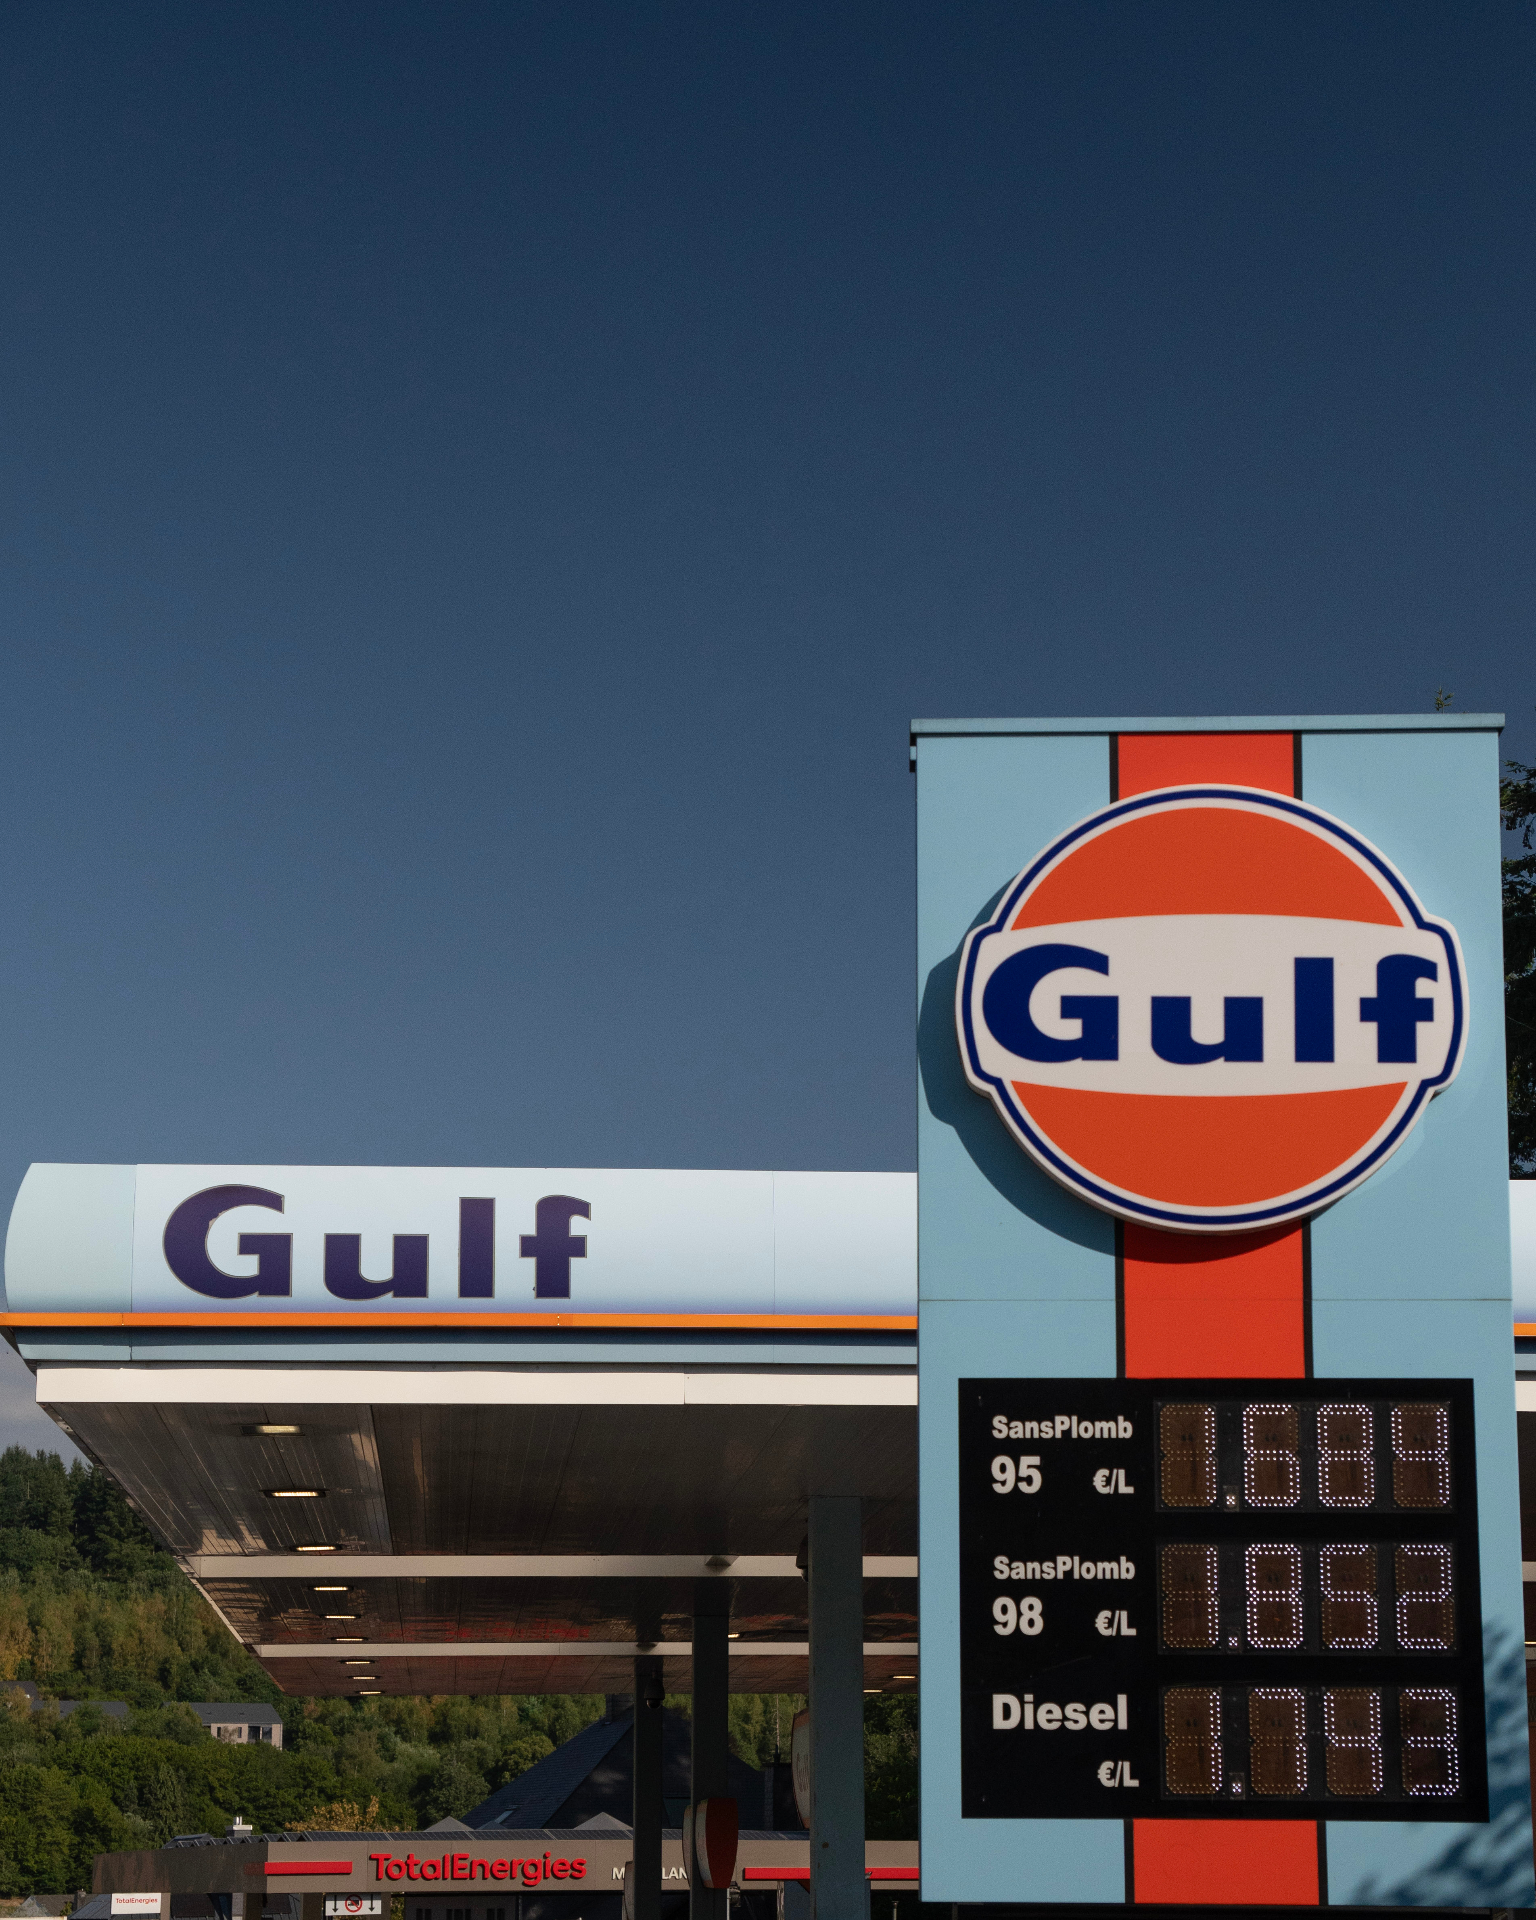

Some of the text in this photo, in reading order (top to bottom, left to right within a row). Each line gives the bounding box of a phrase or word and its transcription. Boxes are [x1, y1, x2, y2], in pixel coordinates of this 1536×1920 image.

[982, 943, 1438, 1065] Gulf
[164, 1186, 589, 1299] Gulf
[992, 1416, 1132, 1438] SansPlomb
[992, 1456, 1133, 1493] 95 €/L
[1205, 1405, 1449, 1507] 1.684
[994, 1556, 1135, 1579] SansPlomb
[1207, 1544, 1451, 1649] 1.852
[993, 1597, 1136, 1635] 98 €/L
[993, 1695, 1127, 1730] Diesel
[1210, 1689, 1459, 1795] 1.743
[1098, 1762, 1139, 1787] €/L
[371, 1852, 586, 1885] TotalEnergies
[115, 1896, 158, 1905] TotalEnergies
